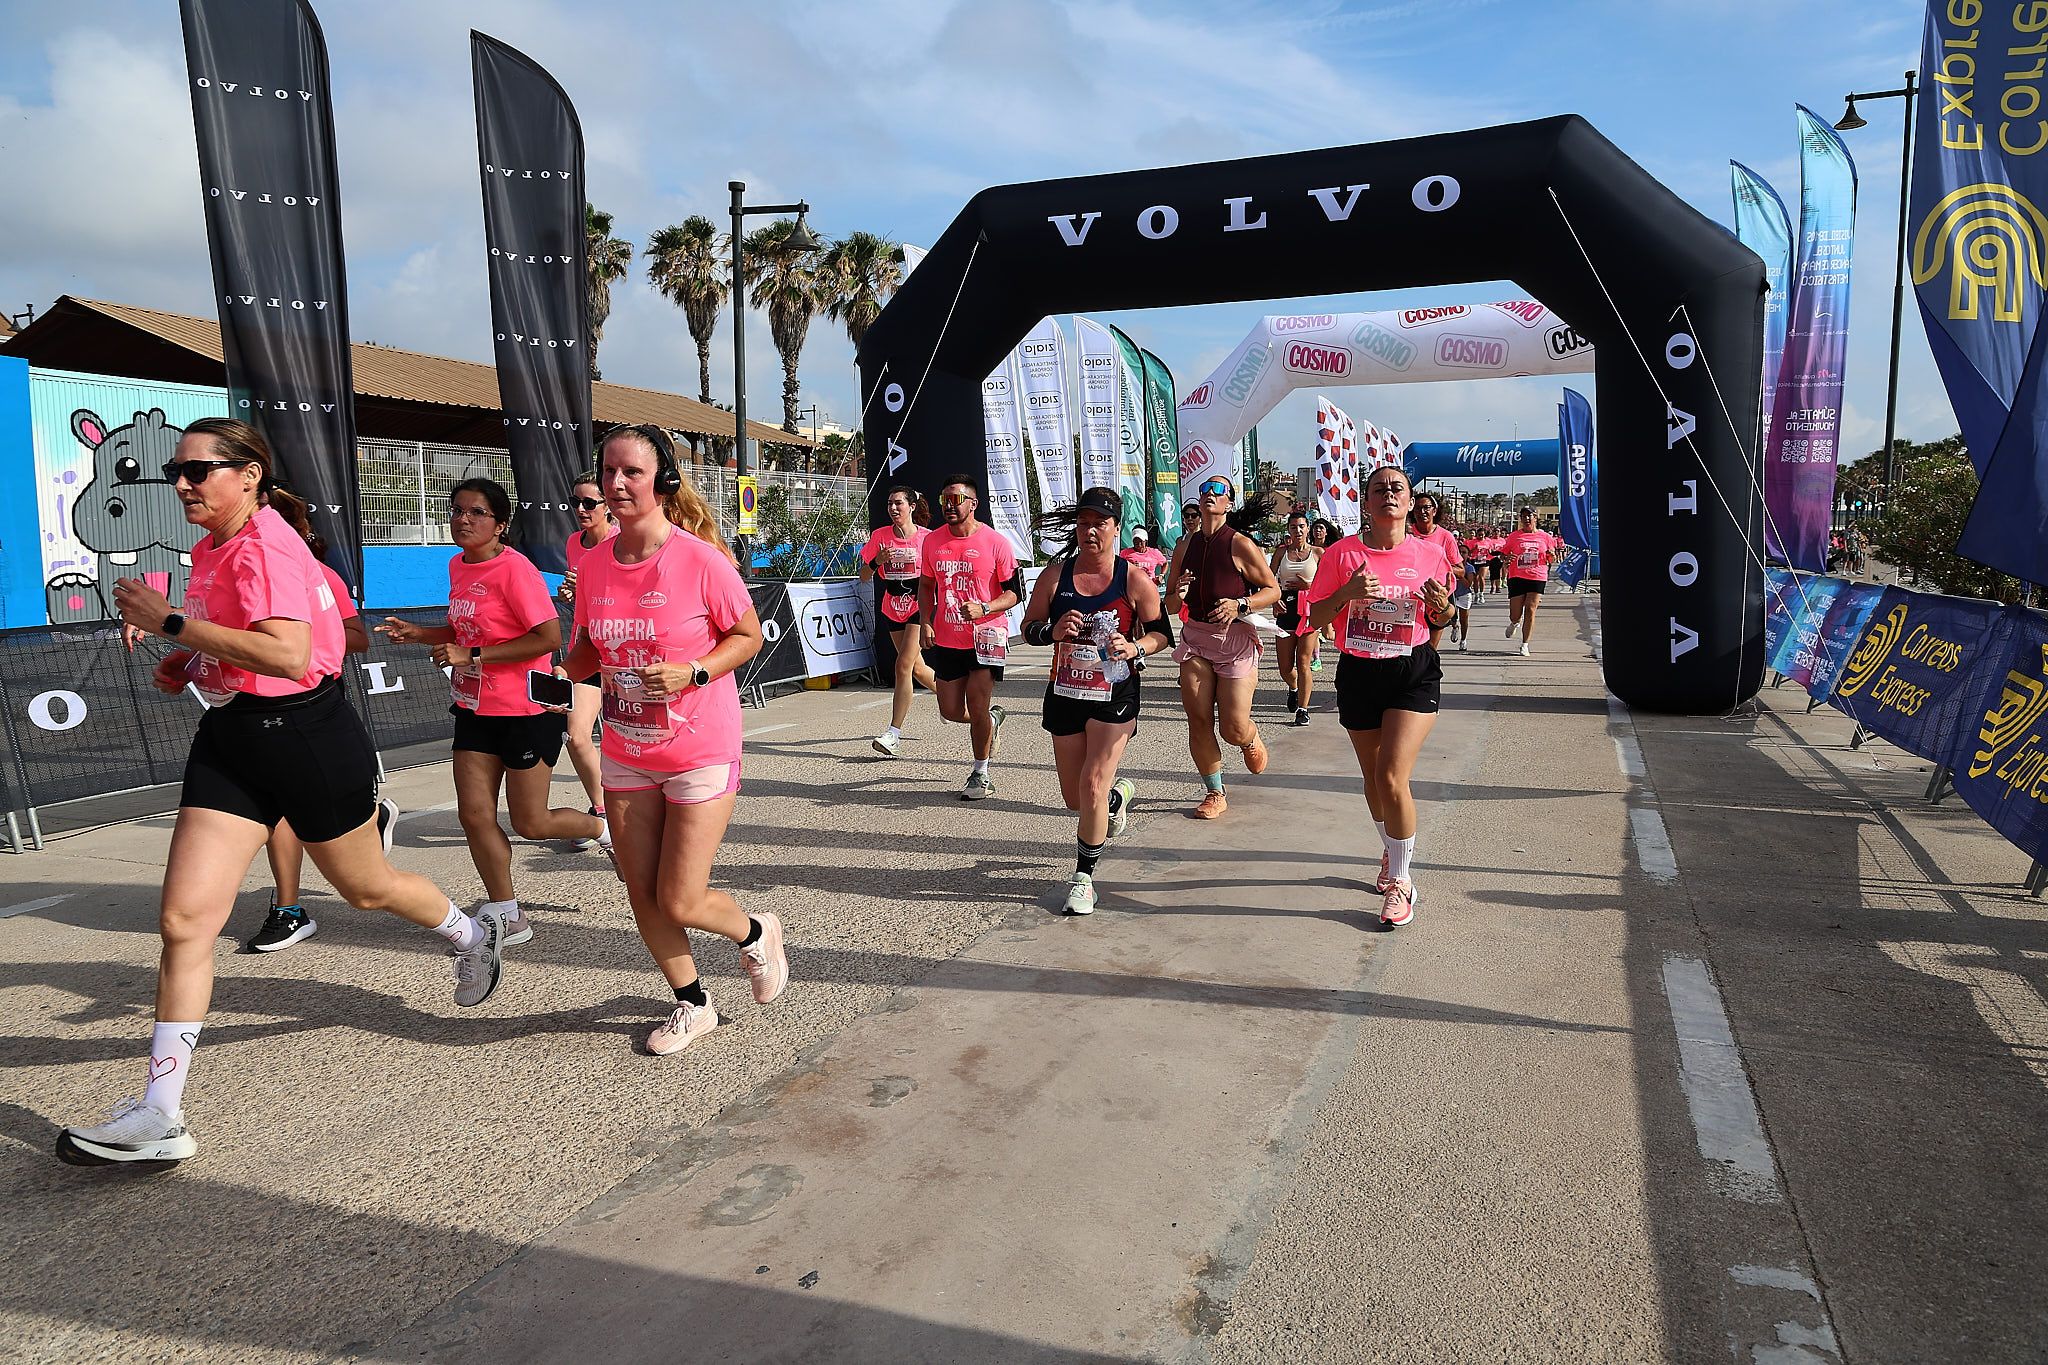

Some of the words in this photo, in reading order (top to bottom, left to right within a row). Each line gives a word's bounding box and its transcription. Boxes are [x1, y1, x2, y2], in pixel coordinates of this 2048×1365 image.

[1048, 175, 1461, 247] VOLVO
[1276, 315, 1333, 331] COSMO
[1404, 305, 1465, 324] COSMO
[1289, 345, 1346, 374] COSMO
[1354, 324, 1412, 367] COSMO
[1440, 338, 1503, 366] COSMO
[1224, 346, 1266, 402] COSMO
[1456, 444, 1522, 473] Marlene
[1665, 333, 1699, 664] VOLVO
[936, 560, 973, 573] CARRERA
[956, 576, 968, 591] DE
[1379, 585, 1410, 599] RERA
[588, 618, 657, 641] CARRERA
[811, 610, 866, 644] ziaja
[1368, 621, 1393, 633] 016
[1901, 623, 1963, 673] Correos
[1071, 669, 1094, 680] 016
[1870, 664, 1931, 717] Express
[618, 699, 643, 714] 016
[1996, 734, 2048, 802] Expre
